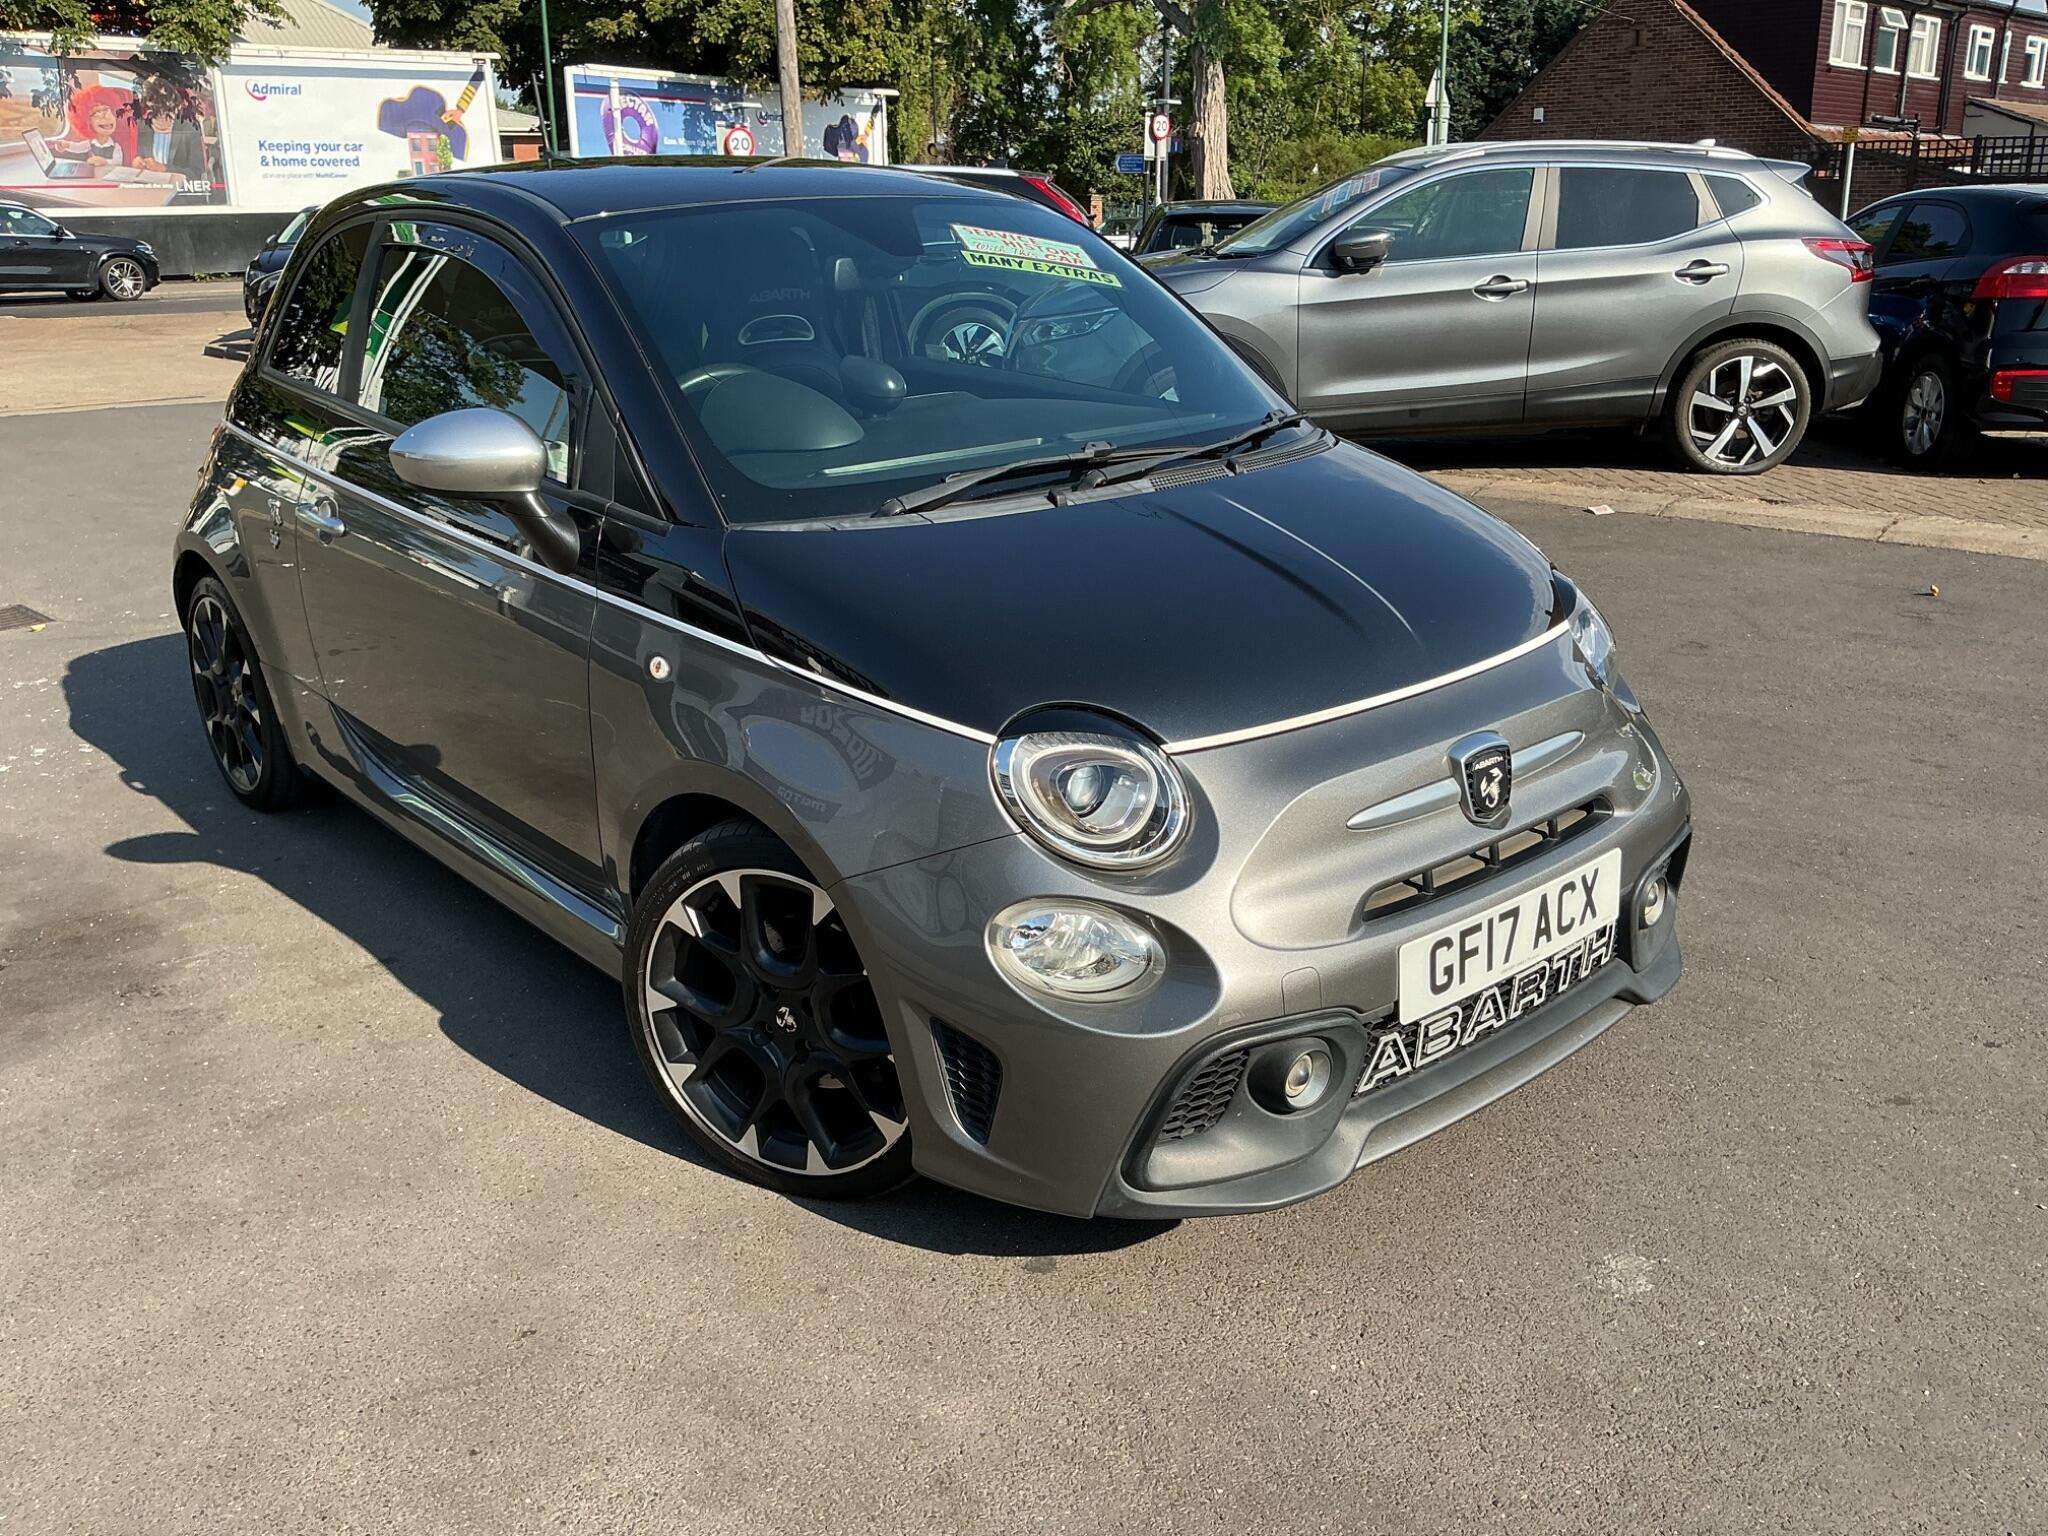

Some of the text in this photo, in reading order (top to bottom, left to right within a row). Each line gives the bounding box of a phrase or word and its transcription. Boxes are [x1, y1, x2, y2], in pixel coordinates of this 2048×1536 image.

[251, 82, 302, 96] Admiral
[1156, 120, 1168, 132] 20
[258, 140, 364, 155] Keeping your car
[731, 137, 751, 151] 20
[260, 155, 361, 167] & home covered
[176, 180, 212, 193] LNER
[962, 226, 1040, 245] SERVICE
[1001, 239, 1082, 258] HISTORY
[1042, 253, 1084, 266] CAR
[969, 253, 1114, 284] MANY EXTRAS
[747, 287, 811, 304] ABARTH
[1473, 756, 1504, 770] ABARTH
[1428, 867, 1599, 997] GF17 ACX
[1355, 920, 1617, 1095] ABARTH
